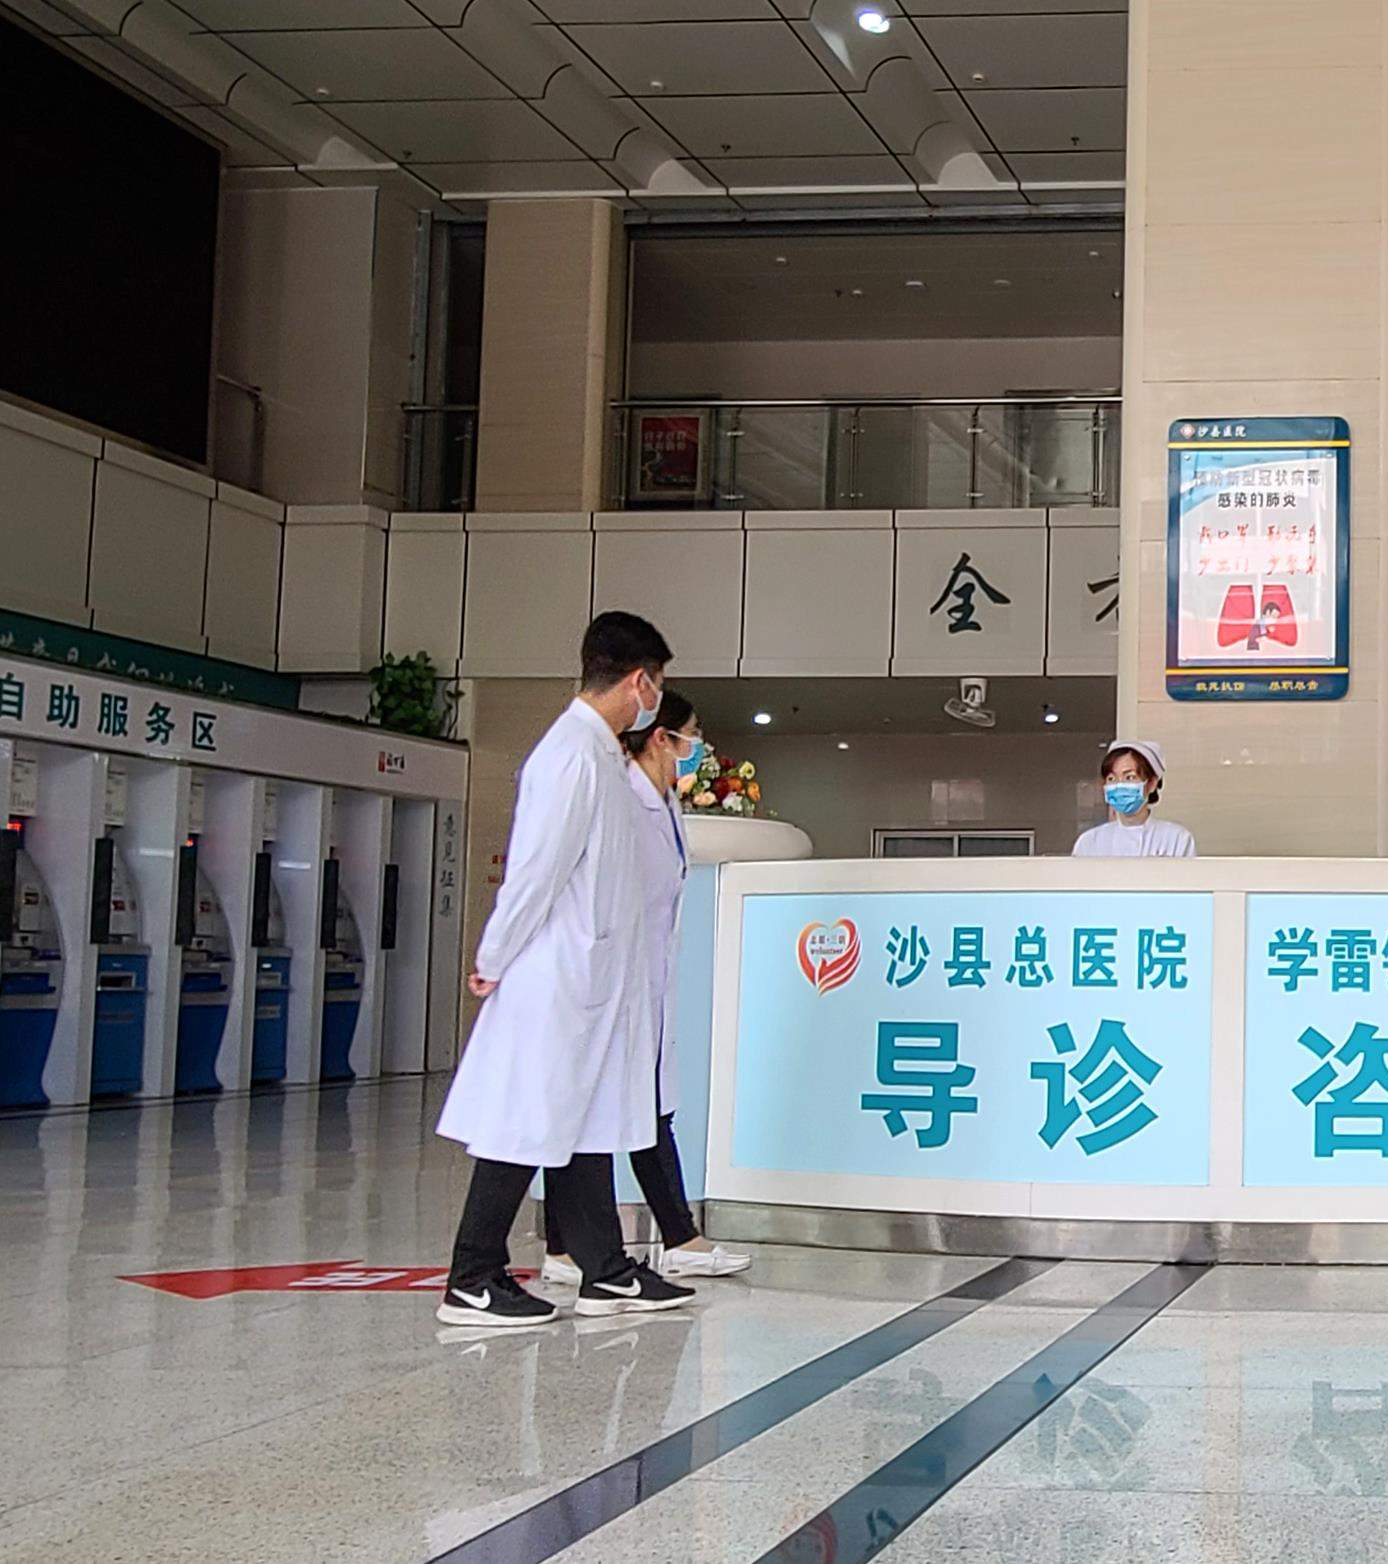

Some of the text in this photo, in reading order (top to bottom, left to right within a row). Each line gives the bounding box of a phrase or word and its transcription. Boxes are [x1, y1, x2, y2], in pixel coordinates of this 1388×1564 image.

[1218, 492, 1297, 508] 感染的肺炎
[0, 672, 217, 752] 自助服务区
[885, 925, 1188, 990] 沙县总医院
[861, 1018, 1163, 1156] 导诊
